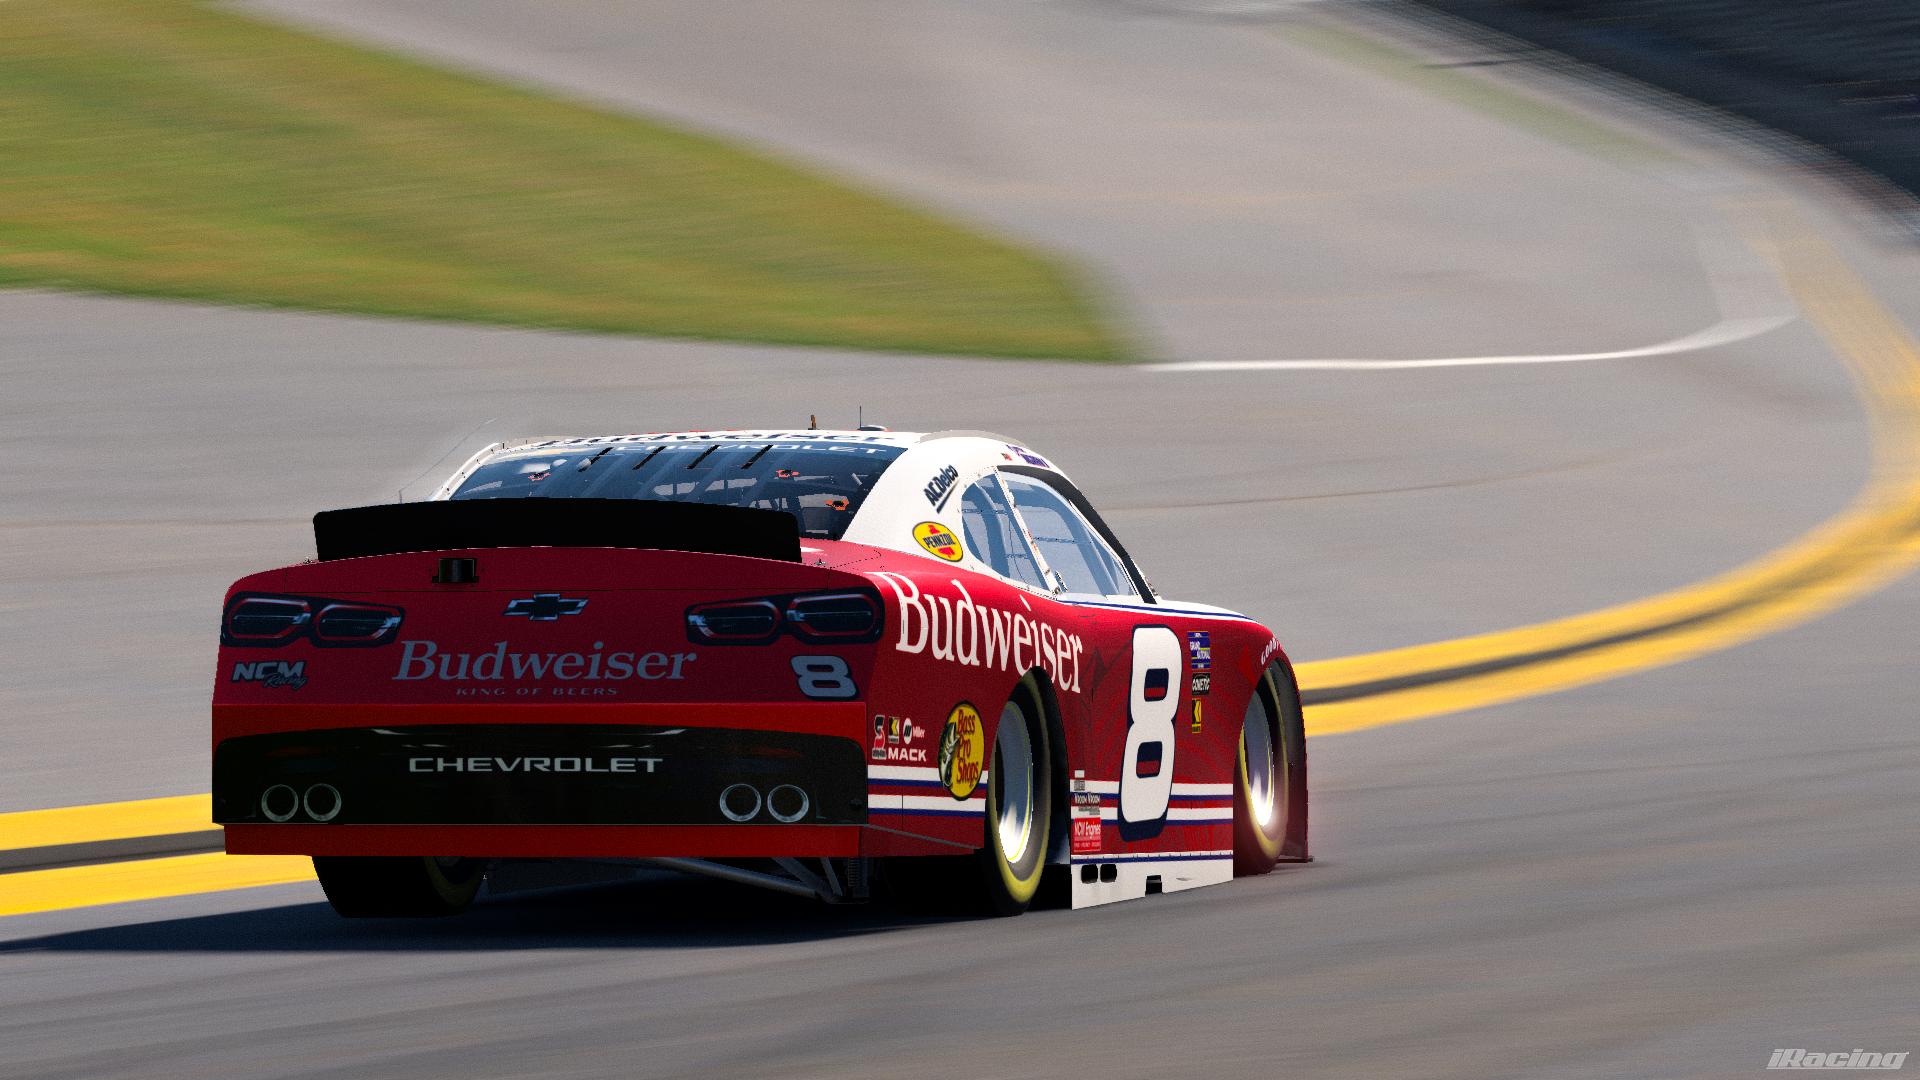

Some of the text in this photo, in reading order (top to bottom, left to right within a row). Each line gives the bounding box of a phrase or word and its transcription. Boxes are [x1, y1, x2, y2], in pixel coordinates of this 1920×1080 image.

[923, 464, 959, 507] ACDelco
[922, 533, 956, 549] PENNZOIL
[864, 571, 1083, 694] Budweiser
[231, 661, 305, 681] NCM
[391, 639, 698, 681] Budweiser
[790, 655, 858, 698] 8
[455, 687, 619, 697] KING OF BEERS
[957, 708, 976, 735] Bass
[1118, 625, 1183, 840] 8
[887, 747, 927, 762] MACK
[957, 735, 972, 760] Pro
[408, 757, 664, 773] CHEVROLET
[956, 760, 979, 788] Shops
